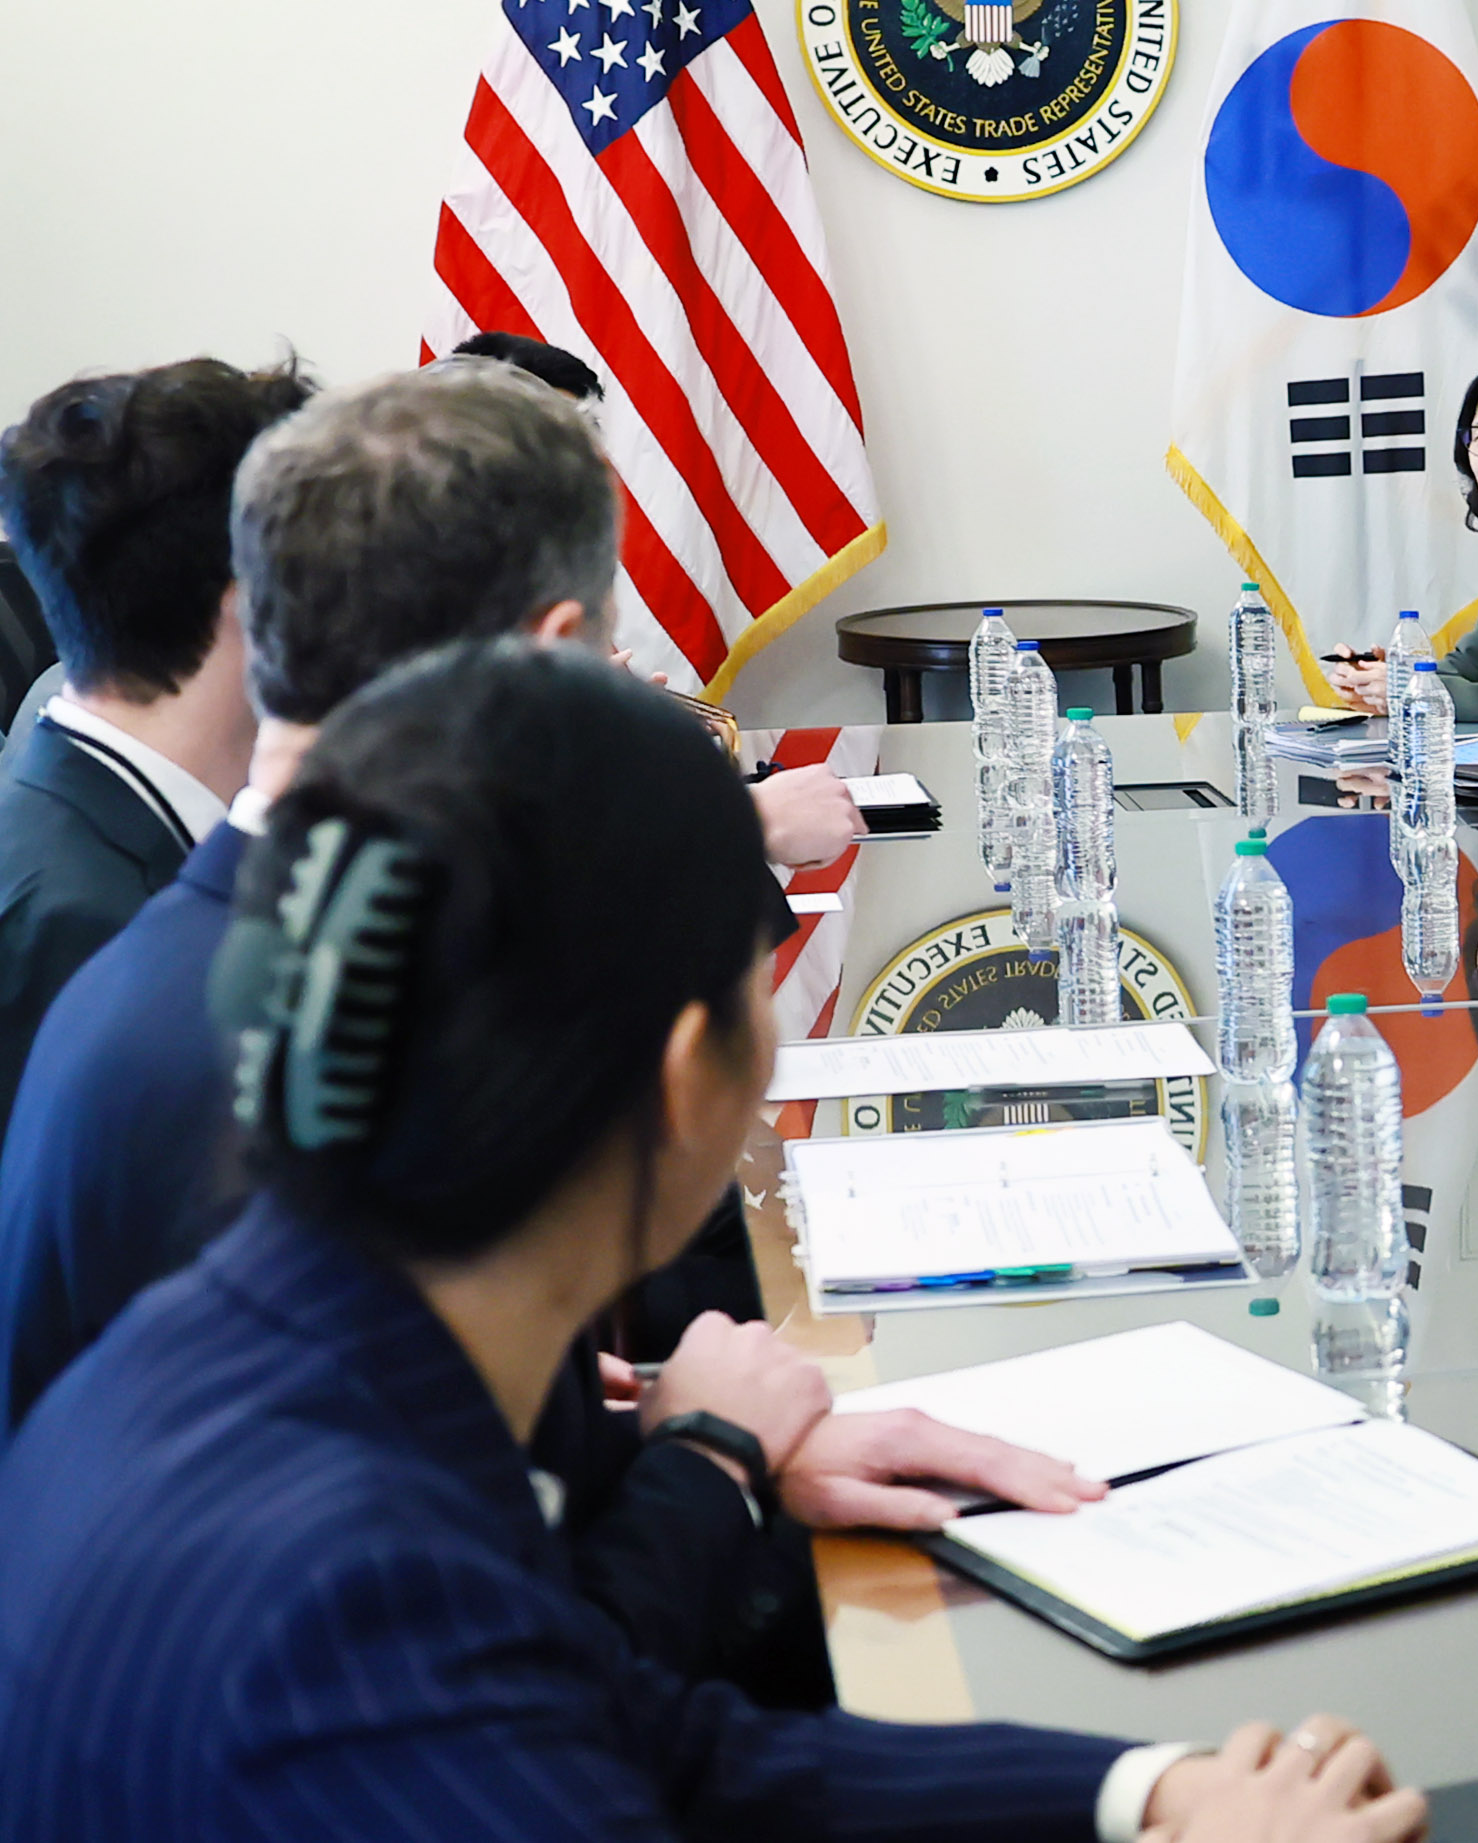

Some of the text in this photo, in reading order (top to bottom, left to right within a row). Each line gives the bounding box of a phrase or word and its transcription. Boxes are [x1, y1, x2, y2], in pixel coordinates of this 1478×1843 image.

[808, 0, 962, 184] EXECUTIVE O
[861, 0, 1116, 138] UNITED STATES TRADE REPRESENTATI
[1022, 0, 1165, 185] NITED STATES
